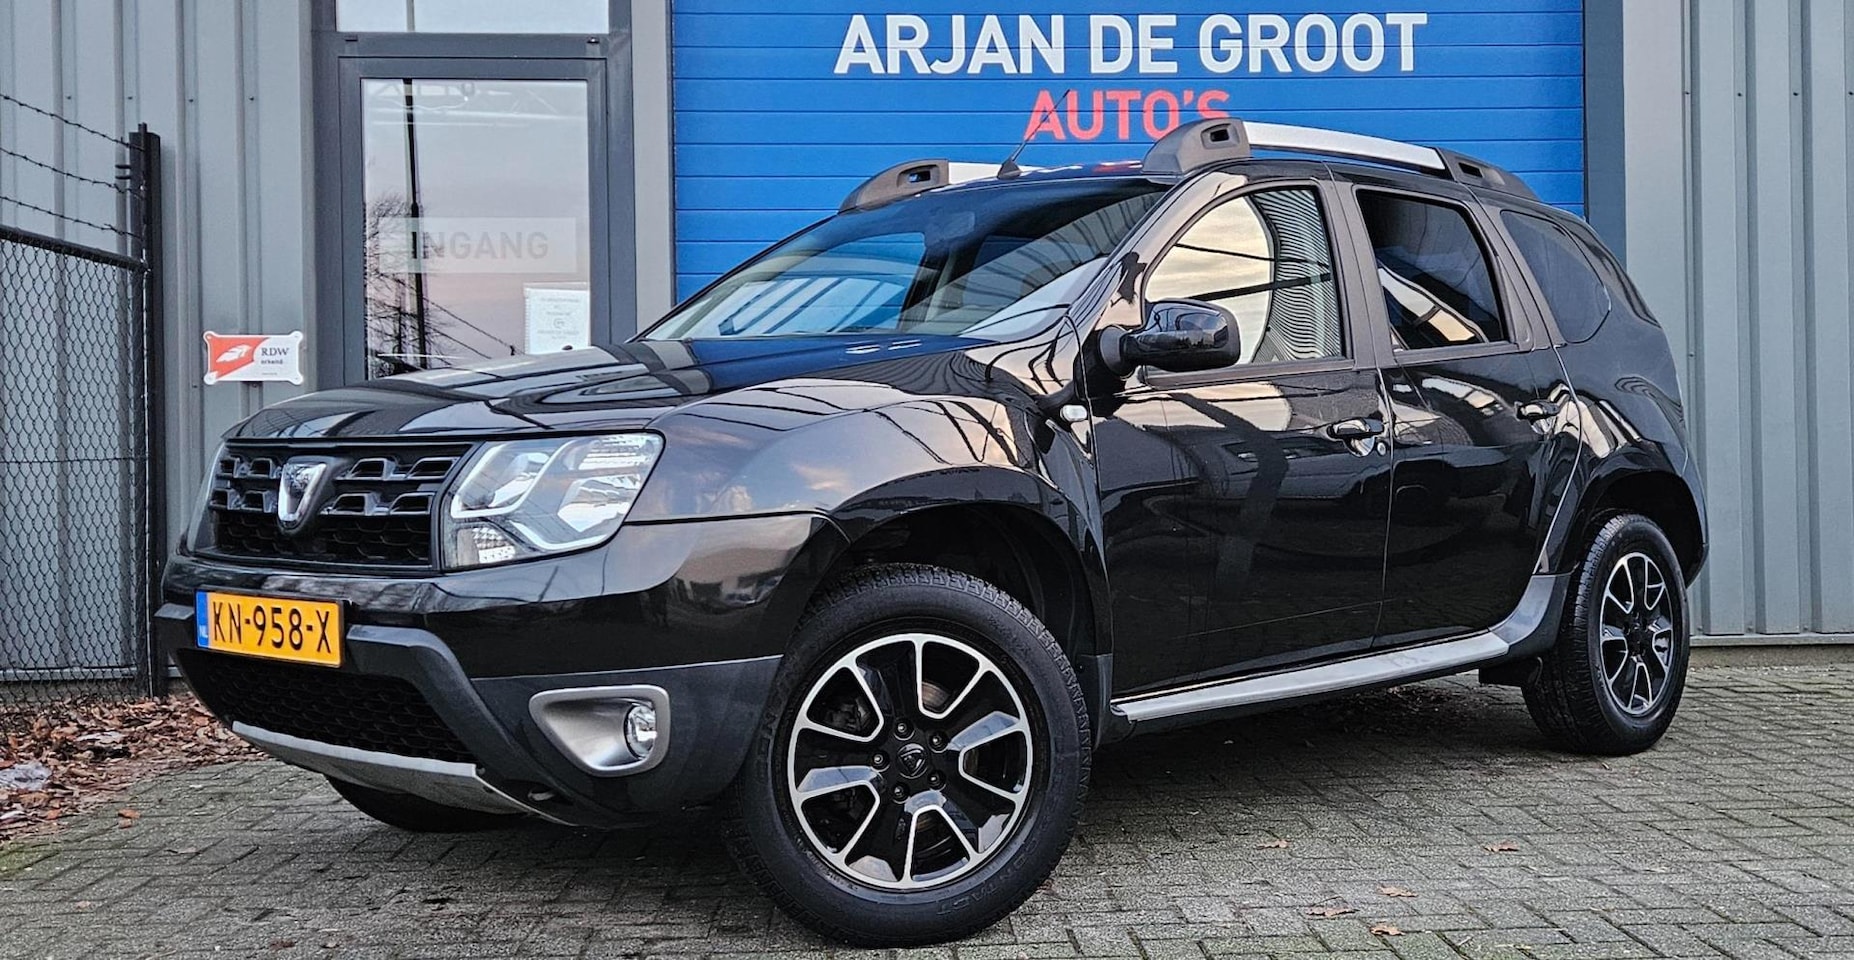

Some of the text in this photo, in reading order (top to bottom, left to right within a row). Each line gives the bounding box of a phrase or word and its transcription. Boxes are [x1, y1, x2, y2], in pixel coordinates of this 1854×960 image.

[833, 13, 1428, 74] ARJAN DE GROOT
[1023, 89, 1230, 141] AUTO'S
[411, 231, 549, 260] INGANG
[261, 347, 289, 357] RDW
[212, 601, 332, 654] KN-958-X
